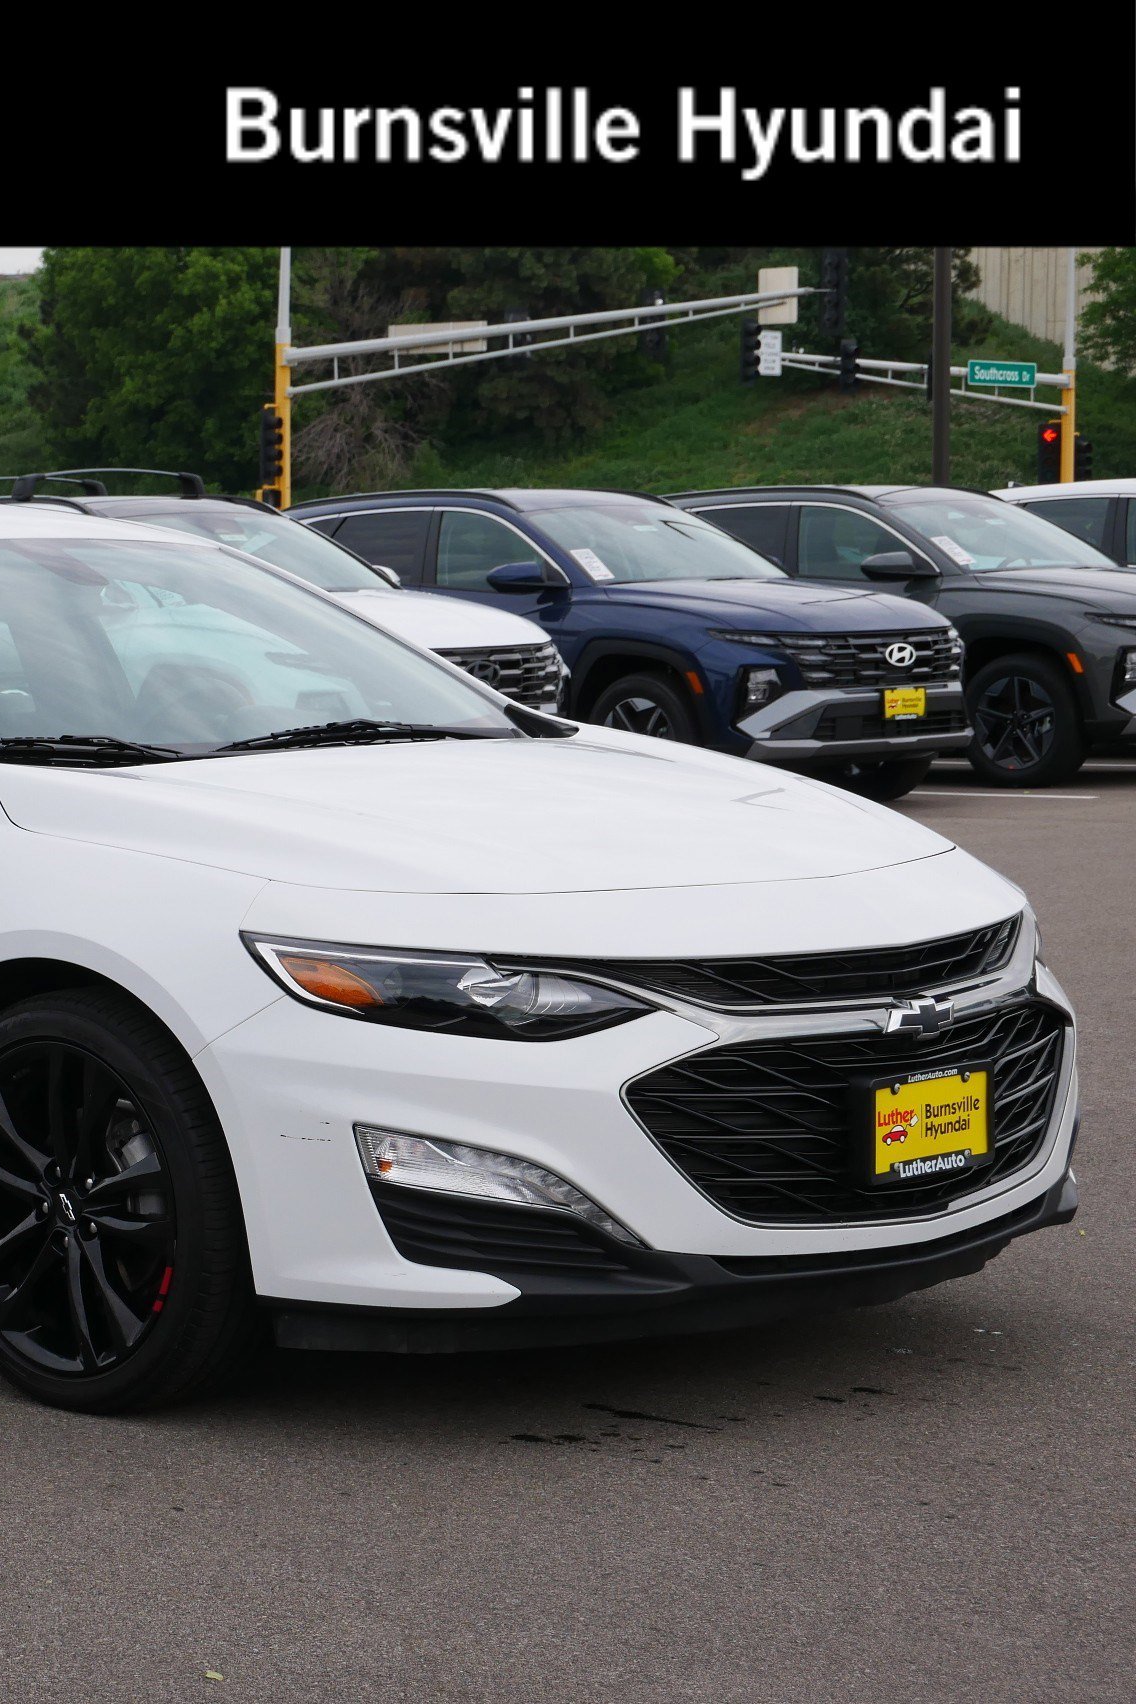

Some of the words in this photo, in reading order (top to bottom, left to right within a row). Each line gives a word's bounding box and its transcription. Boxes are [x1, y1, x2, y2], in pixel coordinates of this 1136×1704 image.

[974, 366, 1019, 381] Southcross
[907, 1068, 958, 1083] LutherAuto.com
[878, 1107, 915, 1127] Luther
[924, 1095, 980, 1120] Burnsville
[924, 1114, 971, 1140] Hyundai
[899, 1153, 965, 1178] LutherAuto
